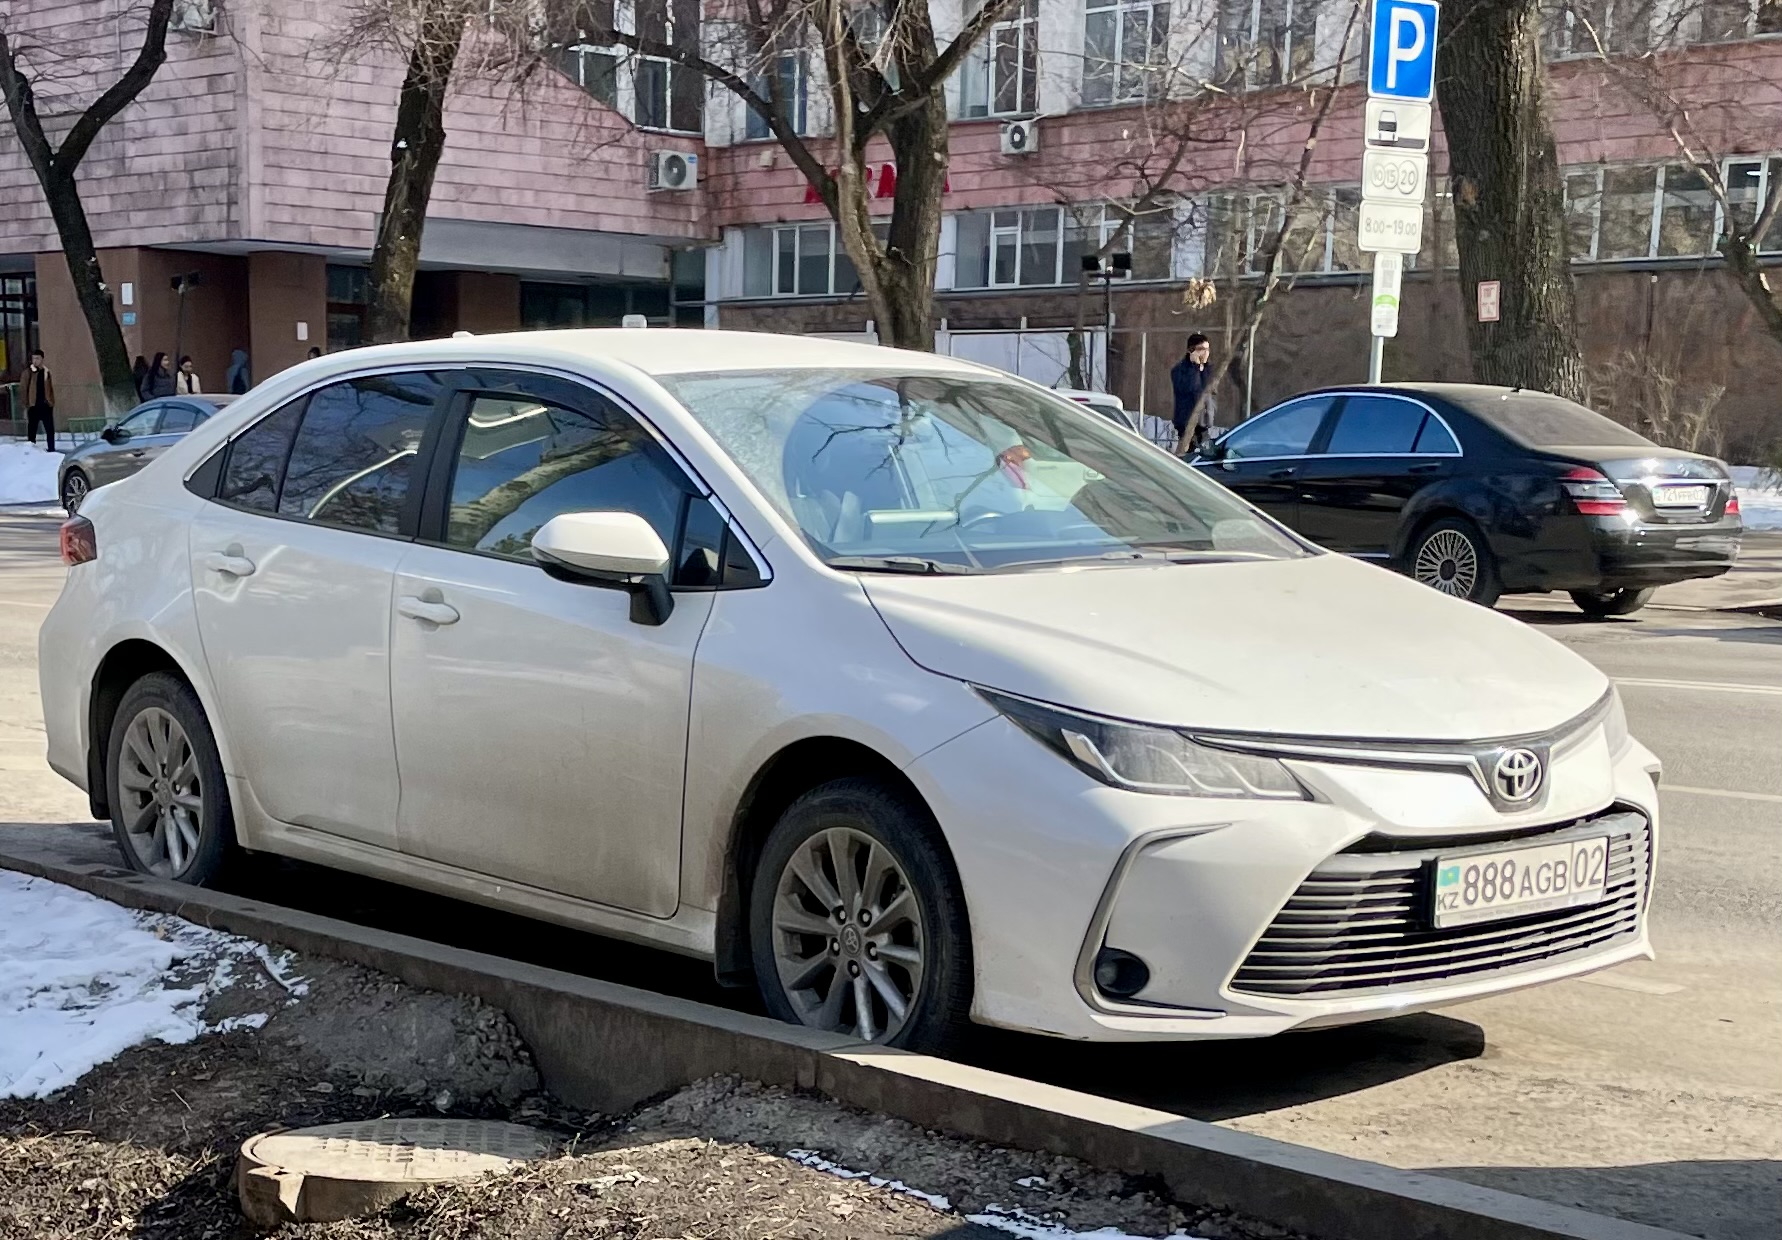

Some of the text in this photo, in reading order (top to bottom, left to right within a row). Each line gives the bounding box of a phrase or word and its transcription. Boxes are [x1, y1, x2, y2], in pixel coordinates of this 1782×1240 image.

[1386, 7, 1426, 89] P
[1387, 169, 1396, 184] 15
[1401, 169, 1416, 186] 20
[1437, 892, 1459, 911] KZ
